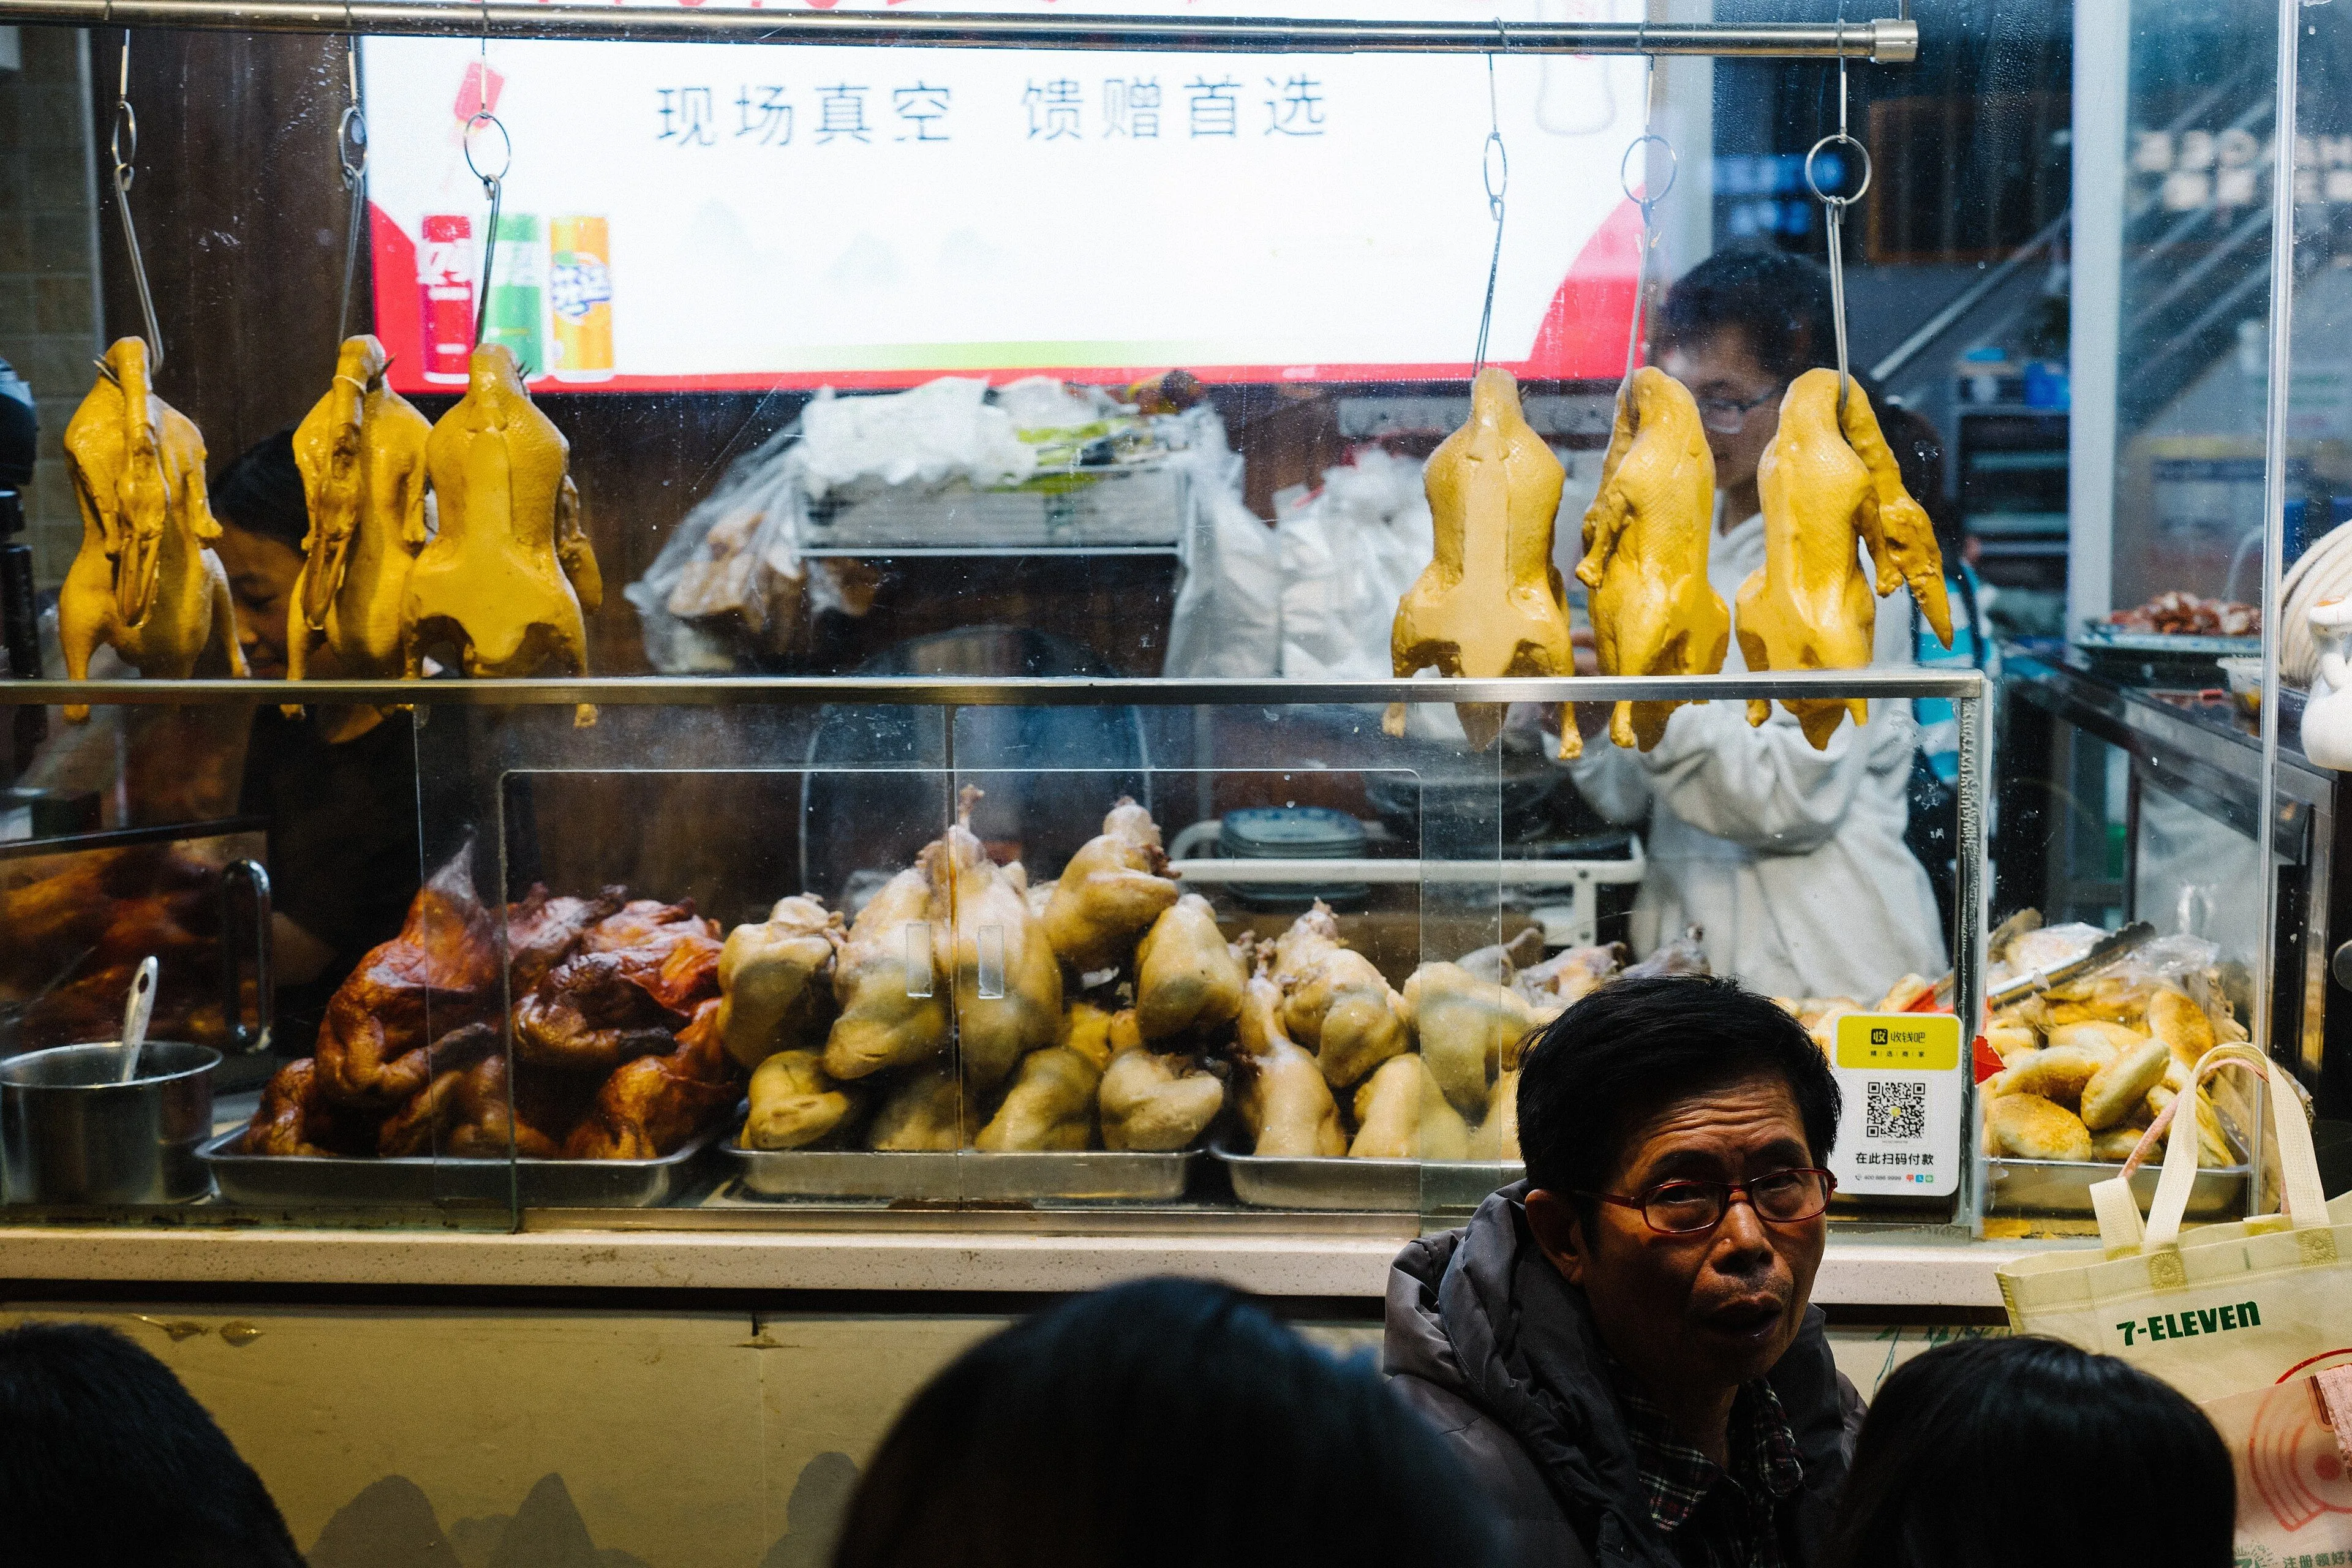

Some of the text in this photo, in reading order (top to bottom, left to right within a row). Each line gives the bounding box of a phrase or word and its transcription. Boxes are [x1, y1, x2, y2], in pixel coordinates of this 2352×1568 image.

[657, 74, 1325, 147] 现场真空 馈赠首选
[1891, 1031, 1925, 1043] 收钱吧
[1856, 1152, 1934, 1165] 在此扫码付款
